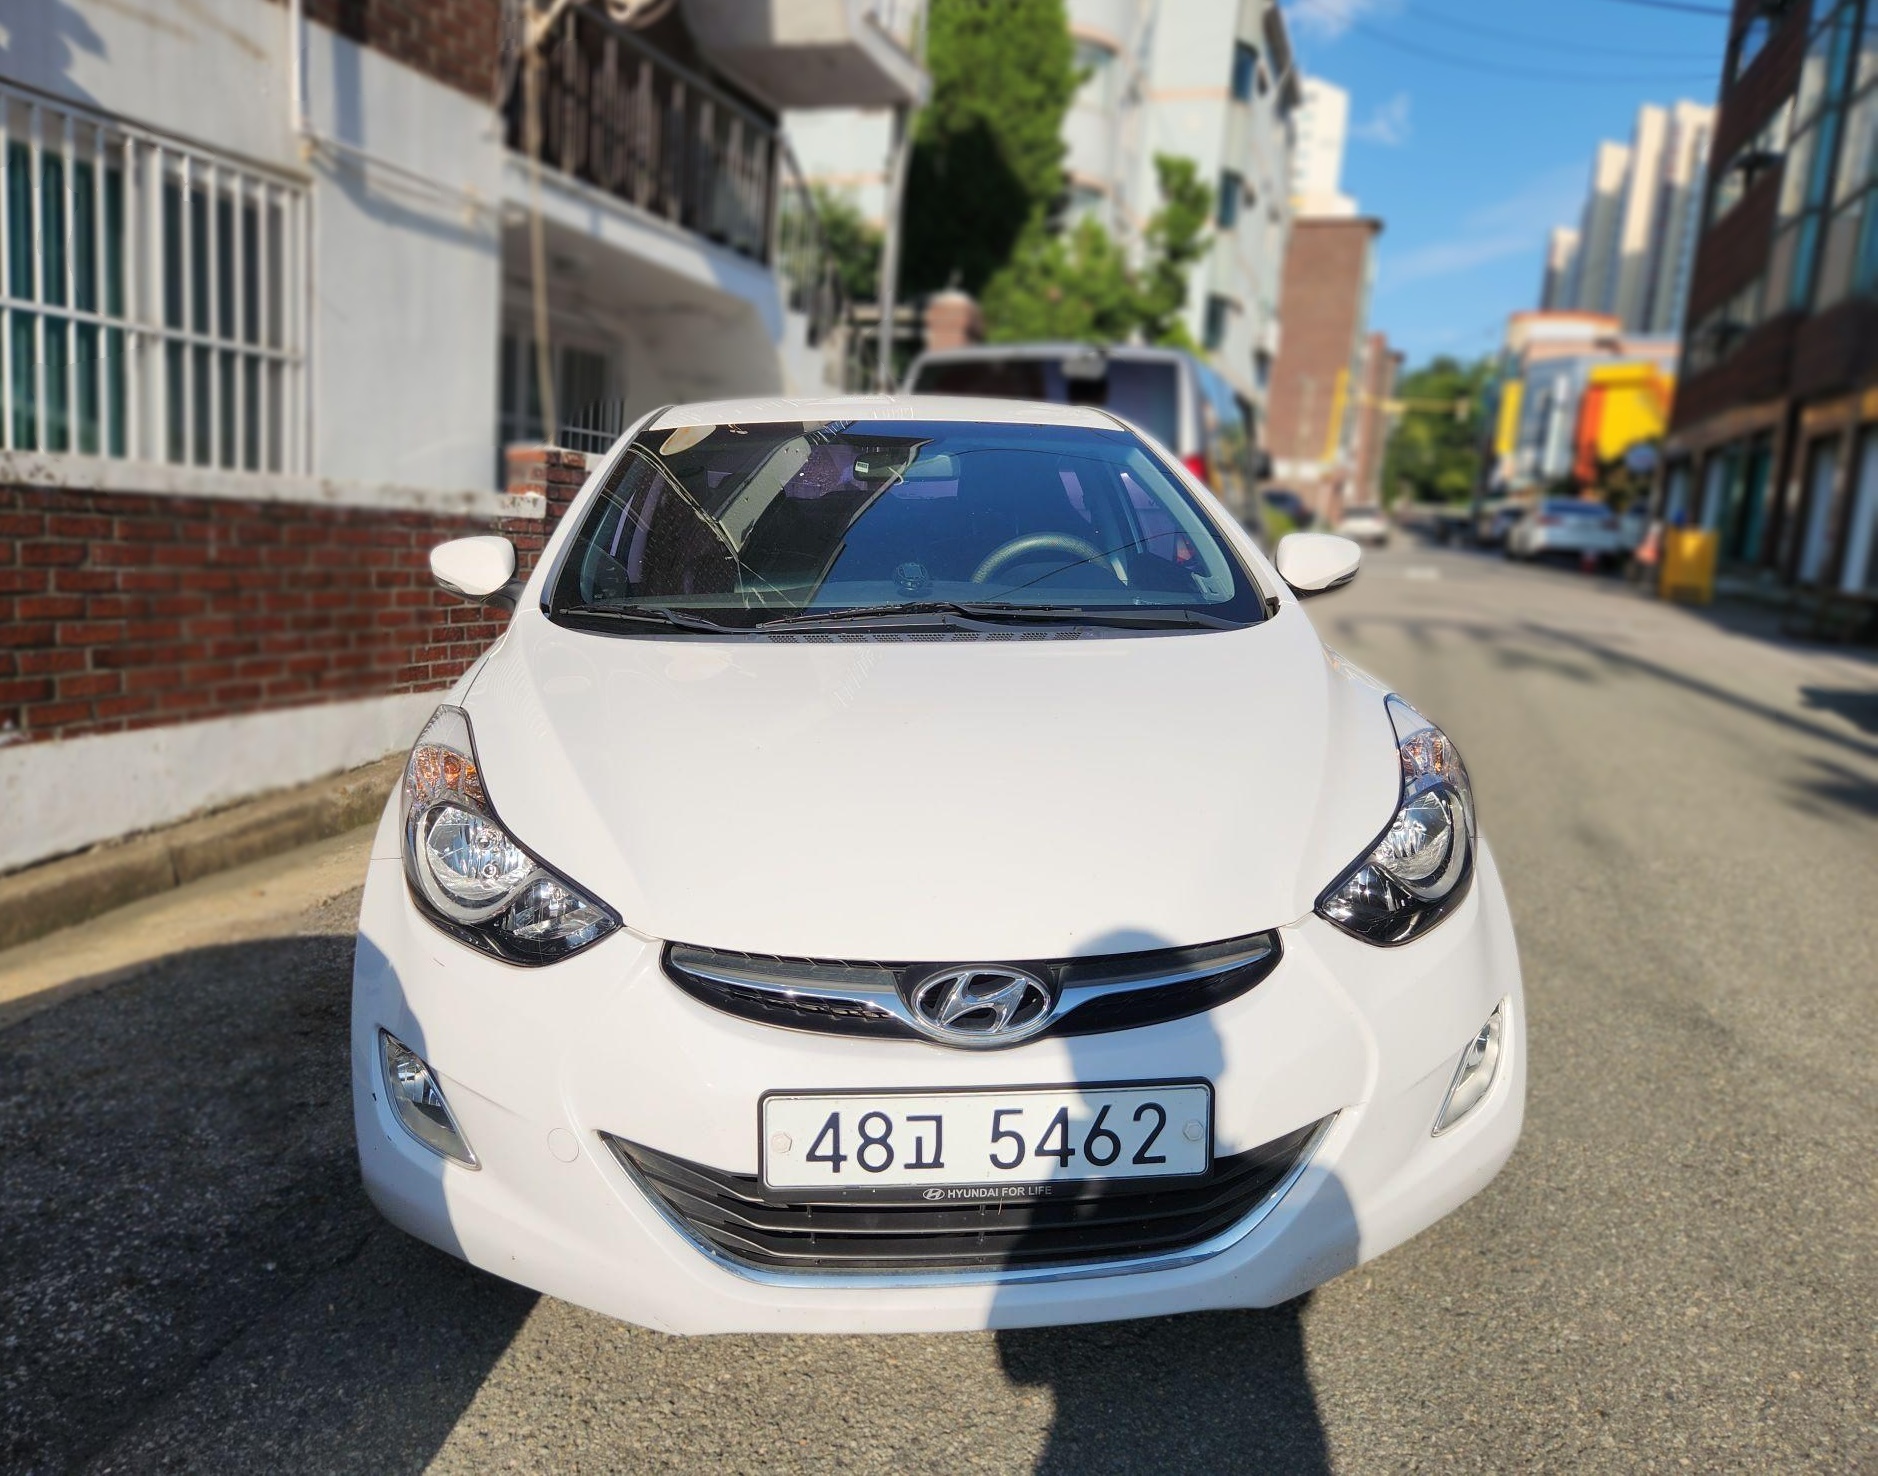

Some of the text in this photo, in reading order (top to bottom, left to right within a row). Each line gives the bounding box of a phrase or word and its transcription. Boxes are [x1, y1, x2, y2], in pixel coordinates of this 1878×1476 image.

[805, 1102, 1167, 1174] 48고 5462
[947, 1185, 1052, 1199] HYUNDAI FOR LIFE
